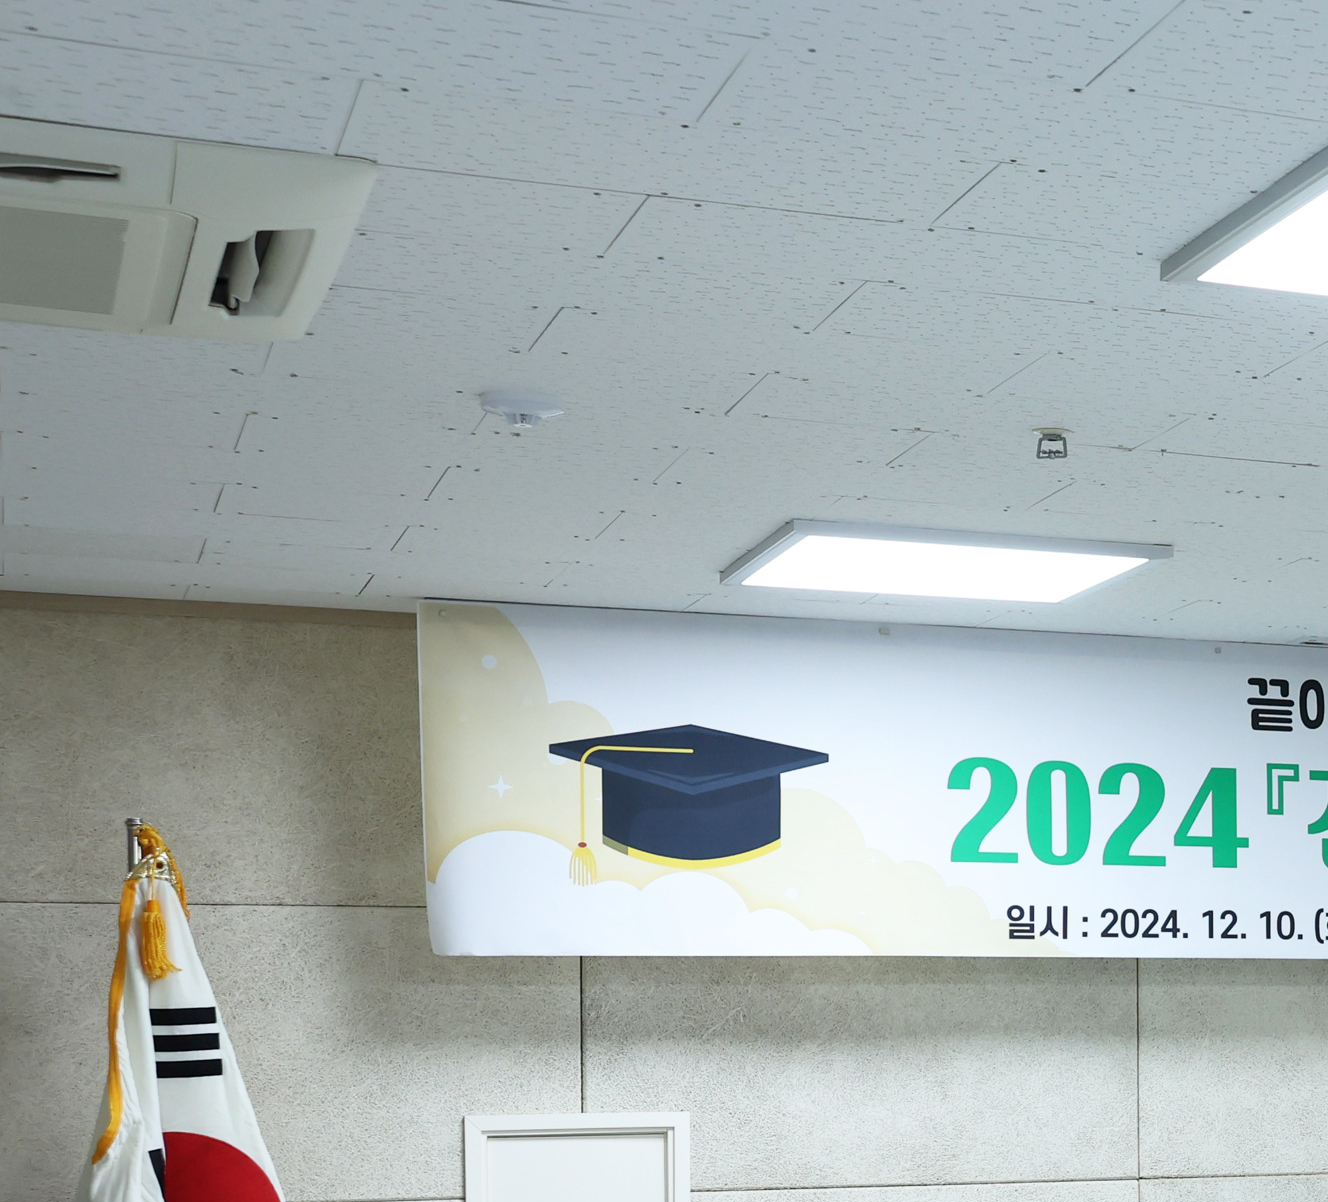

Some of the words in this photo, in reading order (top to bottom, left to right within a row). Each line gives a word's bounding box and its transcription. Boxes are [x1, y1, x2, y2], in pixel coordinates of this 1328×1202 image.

[1006, 904, 1069, 941] 일시
[1082, 916, 1088, 938] :
[1101, 908, 1188, 939] 2024.
[1201, 910, 1246, 939] 12.
[1260, 911, 1304, 941] 10.
